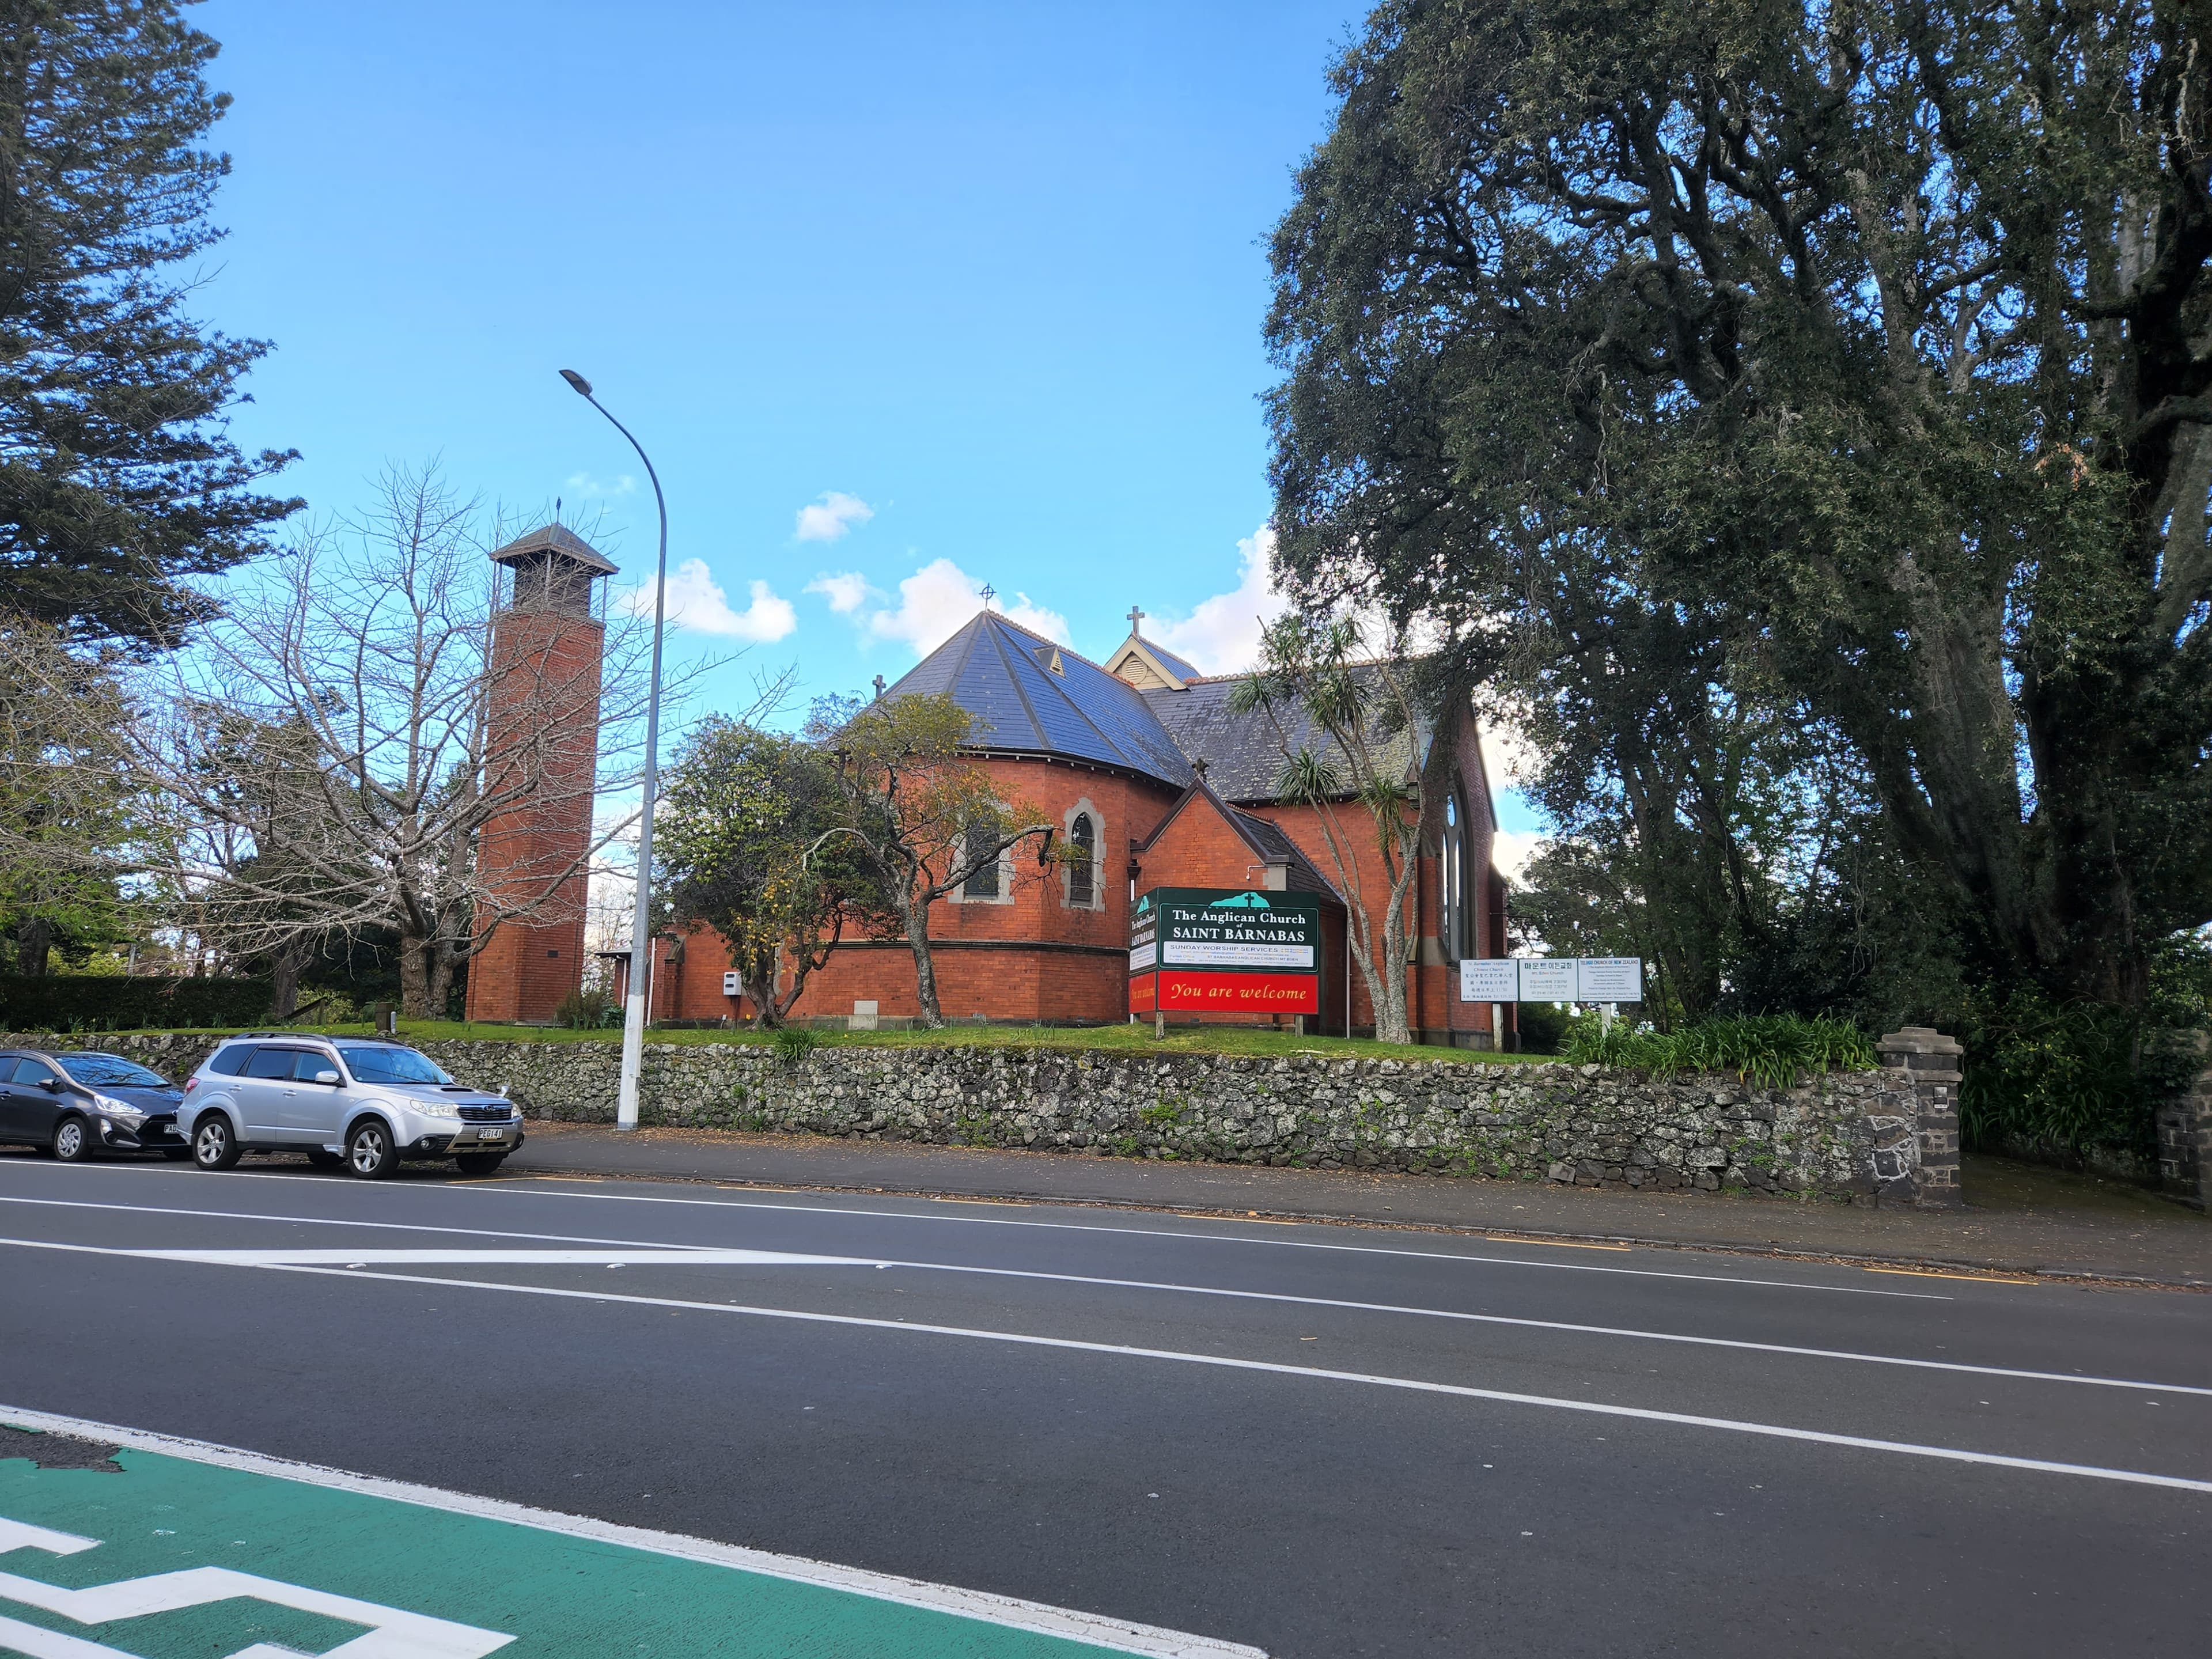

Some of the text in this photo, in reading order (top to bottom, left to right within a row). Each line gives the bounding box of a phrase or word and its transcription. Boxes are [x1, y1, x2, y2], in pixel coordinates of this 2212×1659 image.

[1172, 910, 1306, 925] The Anglican Church
[1173, 927, 1305, 942] SAINT BARNABAS
[1171, 983, 1306, 999] You are welcome
